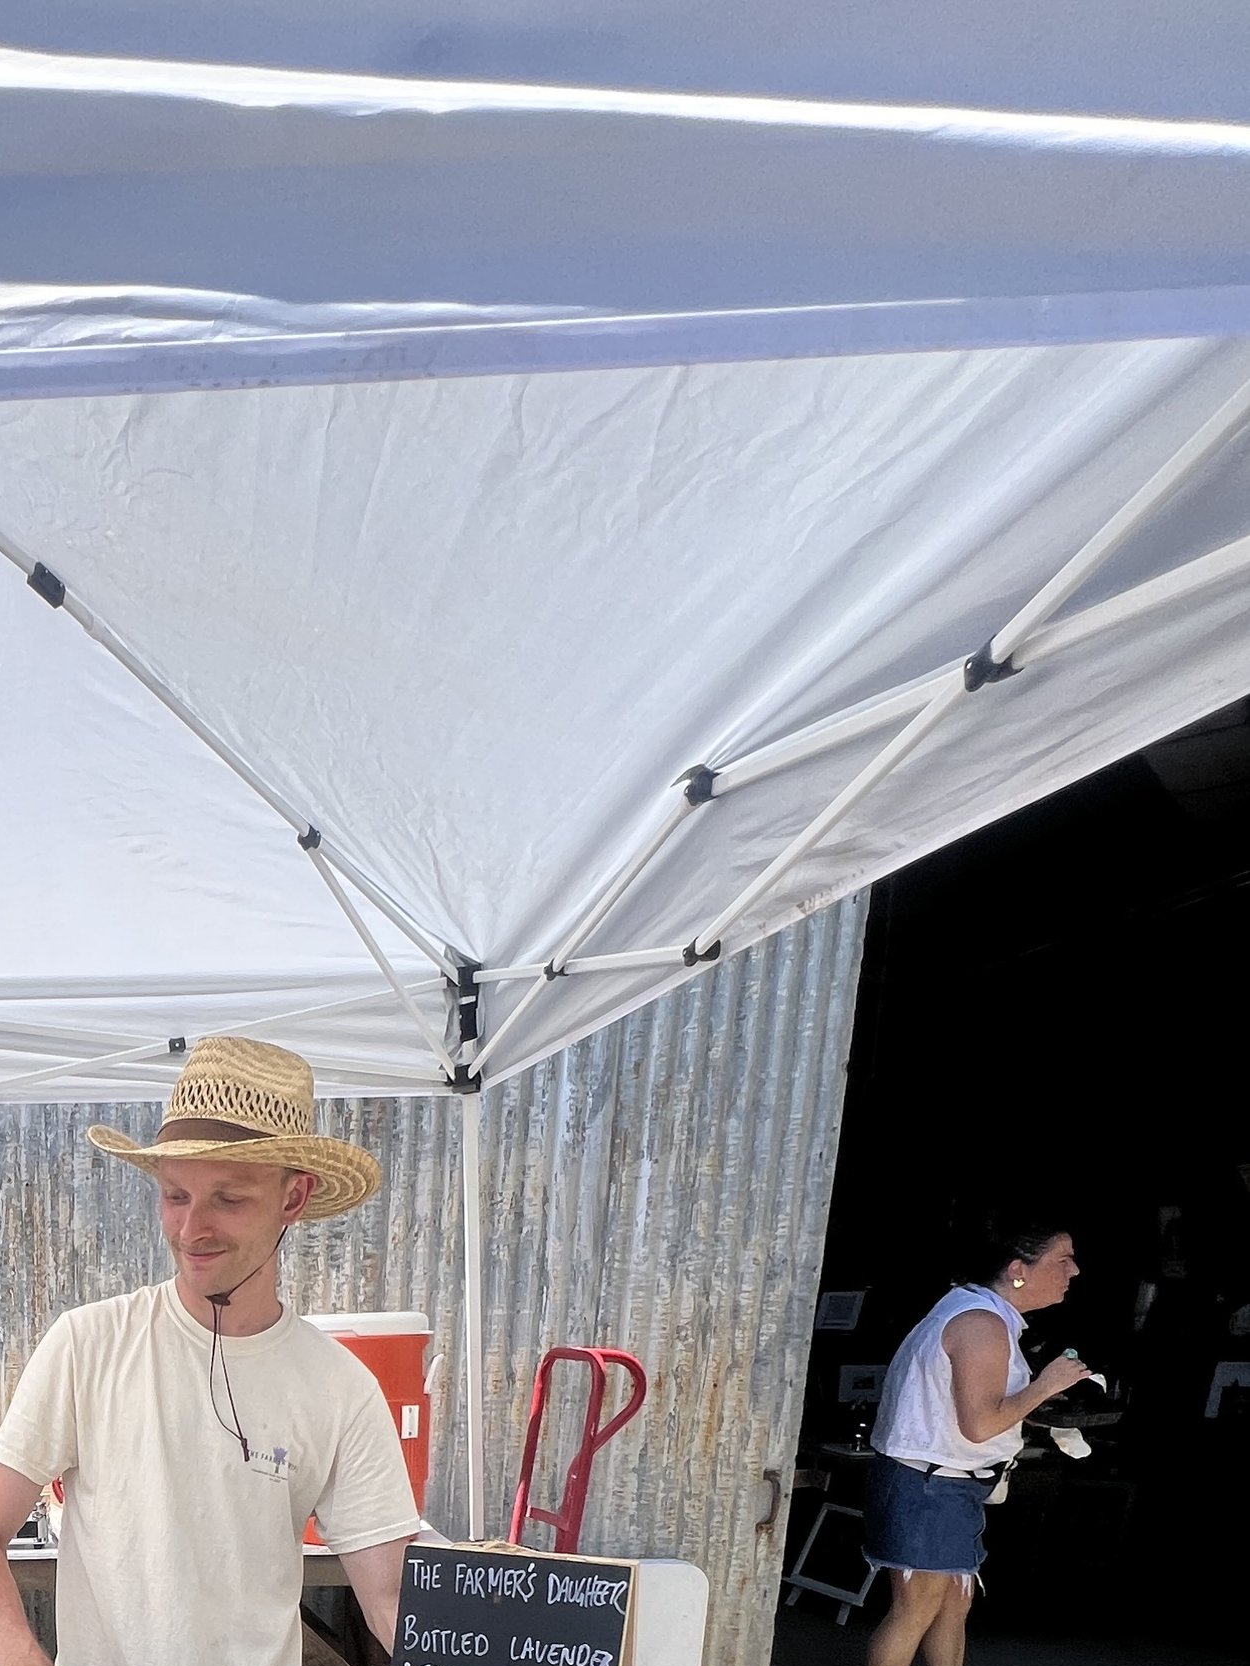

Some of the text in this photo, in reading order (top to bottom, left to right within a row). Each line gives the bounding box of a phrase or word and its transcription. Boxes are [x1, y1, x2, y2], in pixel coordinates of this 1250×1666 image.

[407, 1558, 441, 1591] THE
[455, 1562, 537, 1602] FARMER'S
[404, 1614, 489, 1657] BOTTLED
